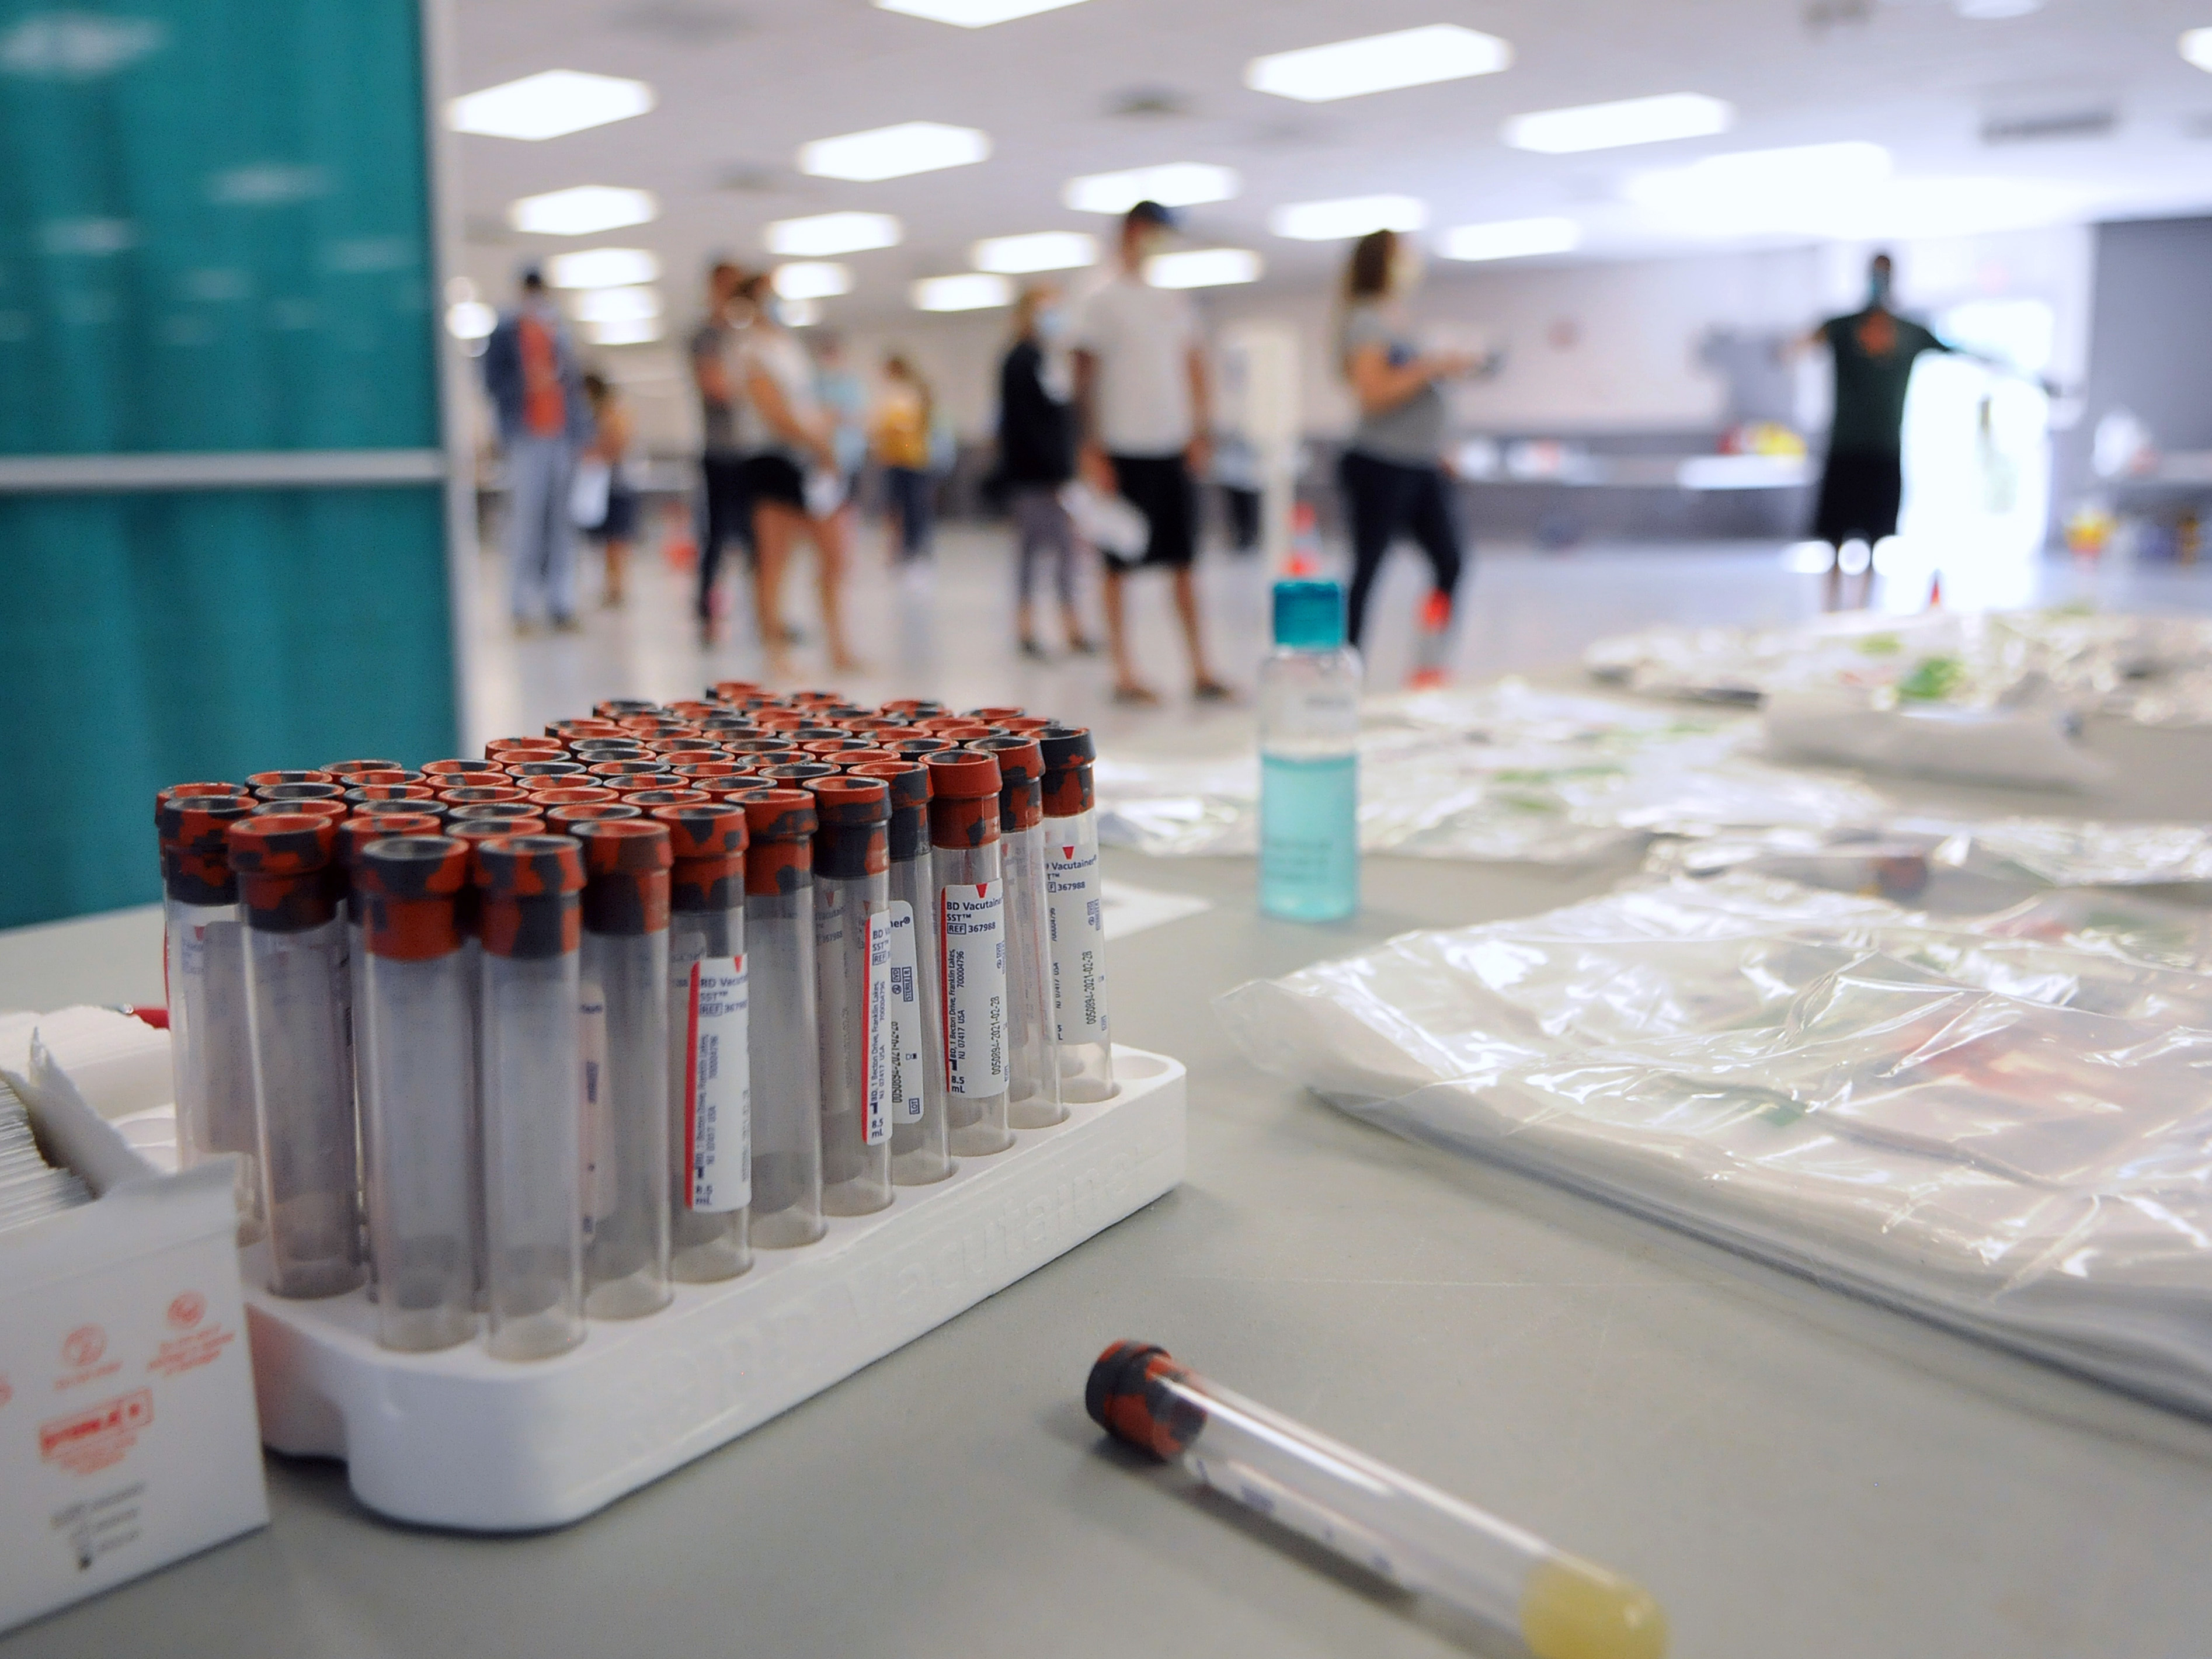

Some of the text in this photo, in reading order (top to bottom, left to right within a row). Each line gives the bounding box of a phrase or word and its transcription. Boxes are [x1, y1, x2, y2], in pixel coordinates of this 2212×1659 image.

[1058, 881, 1086, 891] 367988
[947, 902, 959, 910] BD
[948, 922, 996, 933] REF 367988
[872, 929, 884, 940] BD
[1082, 951, 1096, 1025] 0050894-2021-02-28
[990, 996, 1001, 1075] 0050894-2021-02-28
[958, 1051, 965, 1059] NJ
[951, 1076, 965, 1084] 8.5
[872, 1118, 884, 1128] 8.5
[872, 1128, 883, 1138] mL
